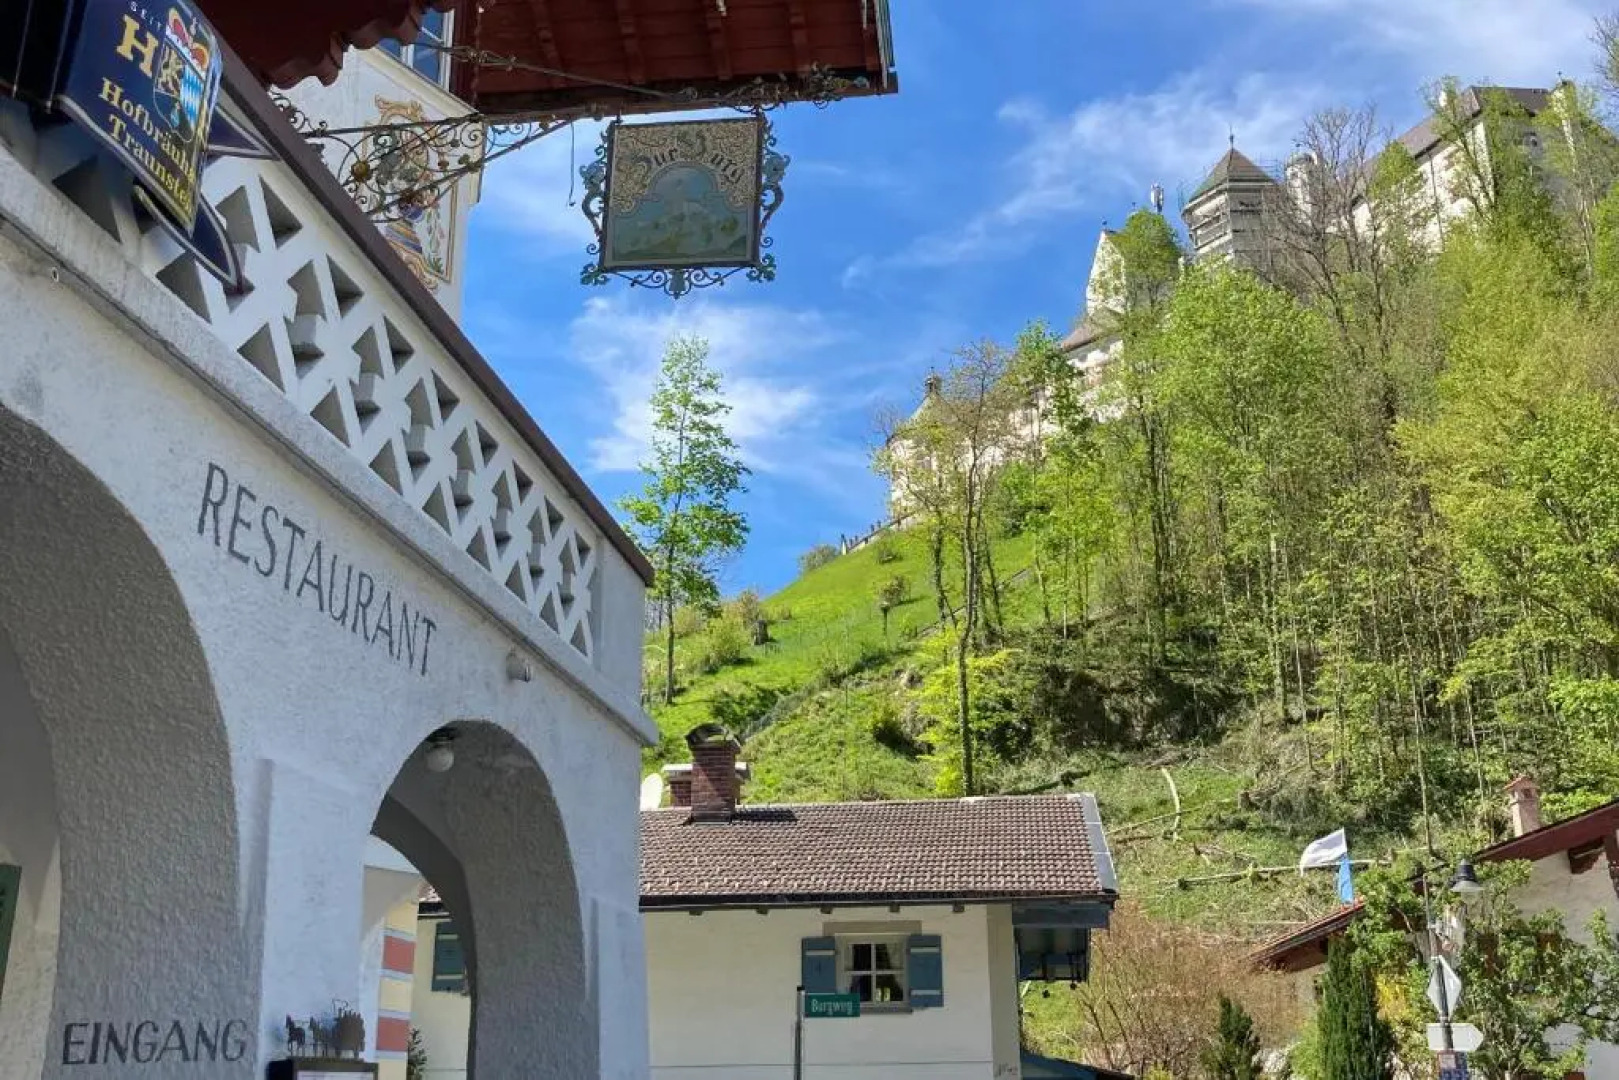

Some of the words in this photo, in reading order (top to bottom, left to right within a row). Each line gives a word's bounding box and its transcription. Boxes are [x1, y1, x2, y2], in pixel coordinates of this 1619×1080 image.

[197, 461, 437, 676] RESTAURANT
[811, 998, 853, 1015] Burgweg
[61, 1019, 248, 1065] EINGANG
